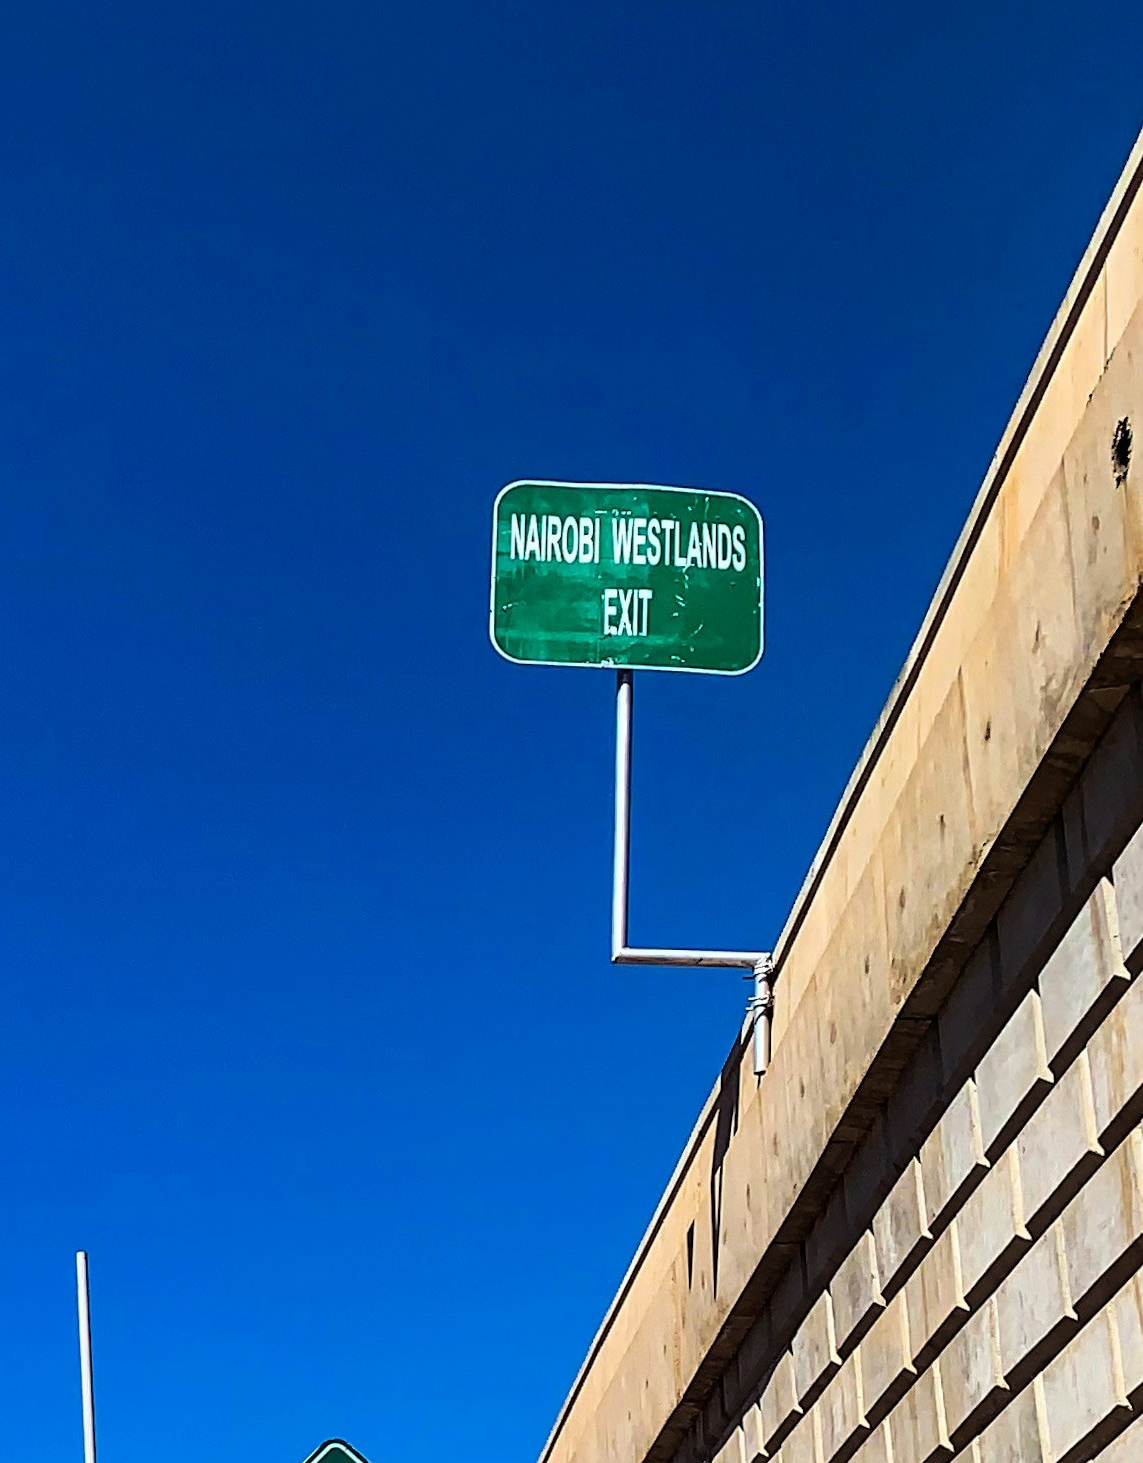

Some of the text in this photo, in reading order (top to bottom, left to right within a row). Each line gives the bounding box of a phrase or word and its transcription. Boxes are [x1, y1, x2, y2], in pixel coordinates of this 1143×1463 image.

[510, 513, 747, 572] NAIROBI WESTLANDS
[603, 588, 653, 637] EXIT
